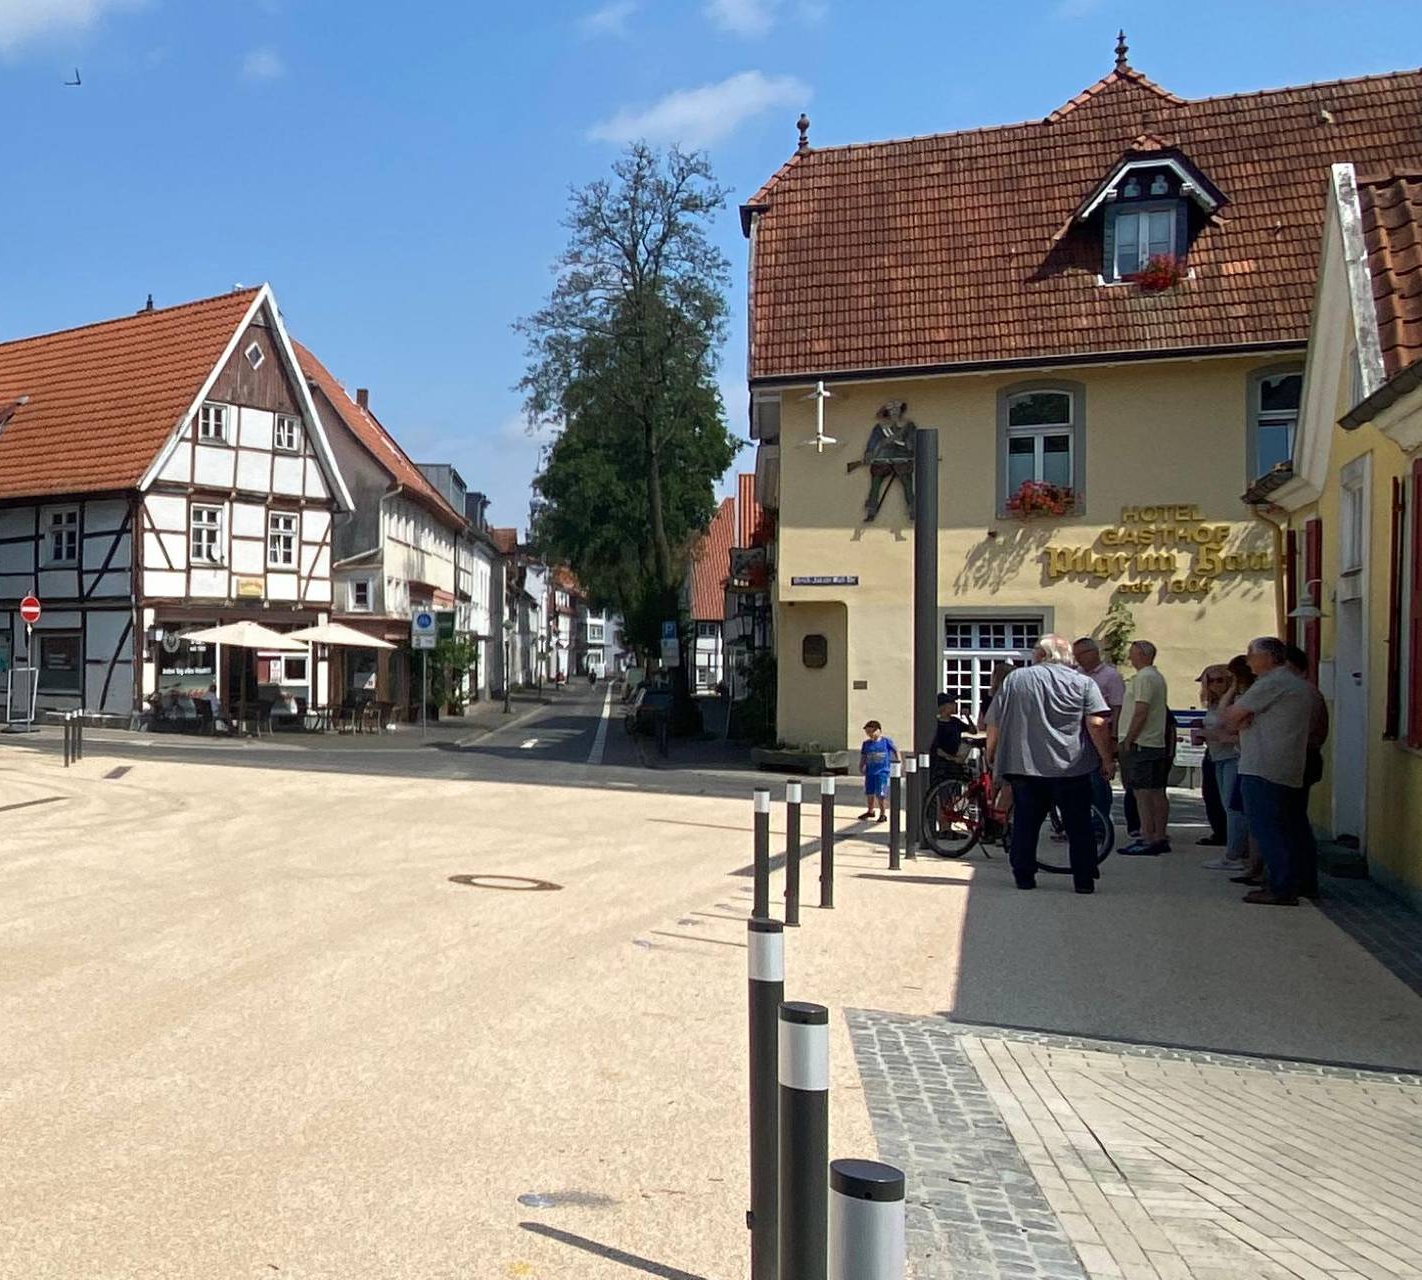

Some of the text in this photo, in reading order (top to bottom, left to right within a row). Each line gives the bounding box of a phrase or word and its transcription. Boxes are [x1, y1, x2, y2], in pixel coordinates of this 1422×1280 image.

[1121, 503, 1206, 523] HOTEL
[1099, 525, 1230, 546] GASTHOF
[1044, 543, 1286, 579] Pilgrim Hau
[665, 623, 674, 634] P
